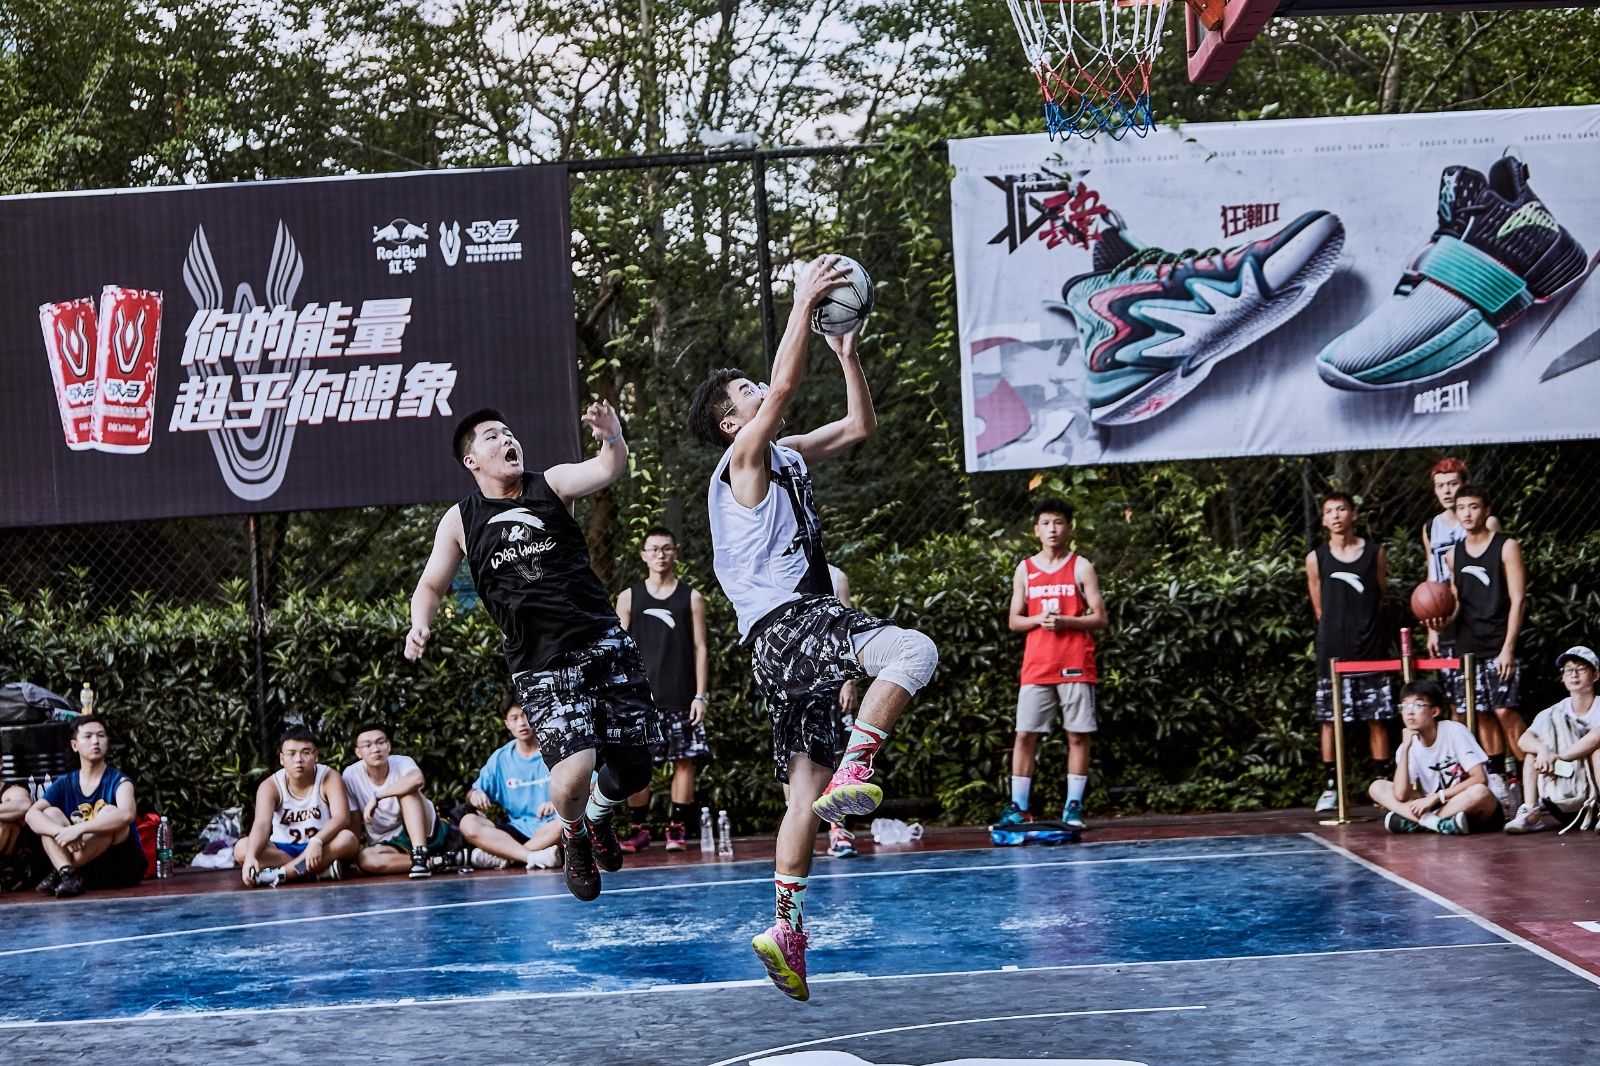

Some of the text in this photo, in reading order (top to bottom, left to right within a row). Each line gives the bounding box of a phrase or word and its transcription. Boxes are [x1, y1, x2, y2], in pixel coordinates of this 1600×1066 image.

[388, 259, 416, 274] 红牛
[181, 298, 412, 366] 你的能量
[169, 361, 457, 432] 超乎你想象
[490, 536, 557, 570] WAR HORSE
[1029, 584, 1075, 599] ROCKETS
